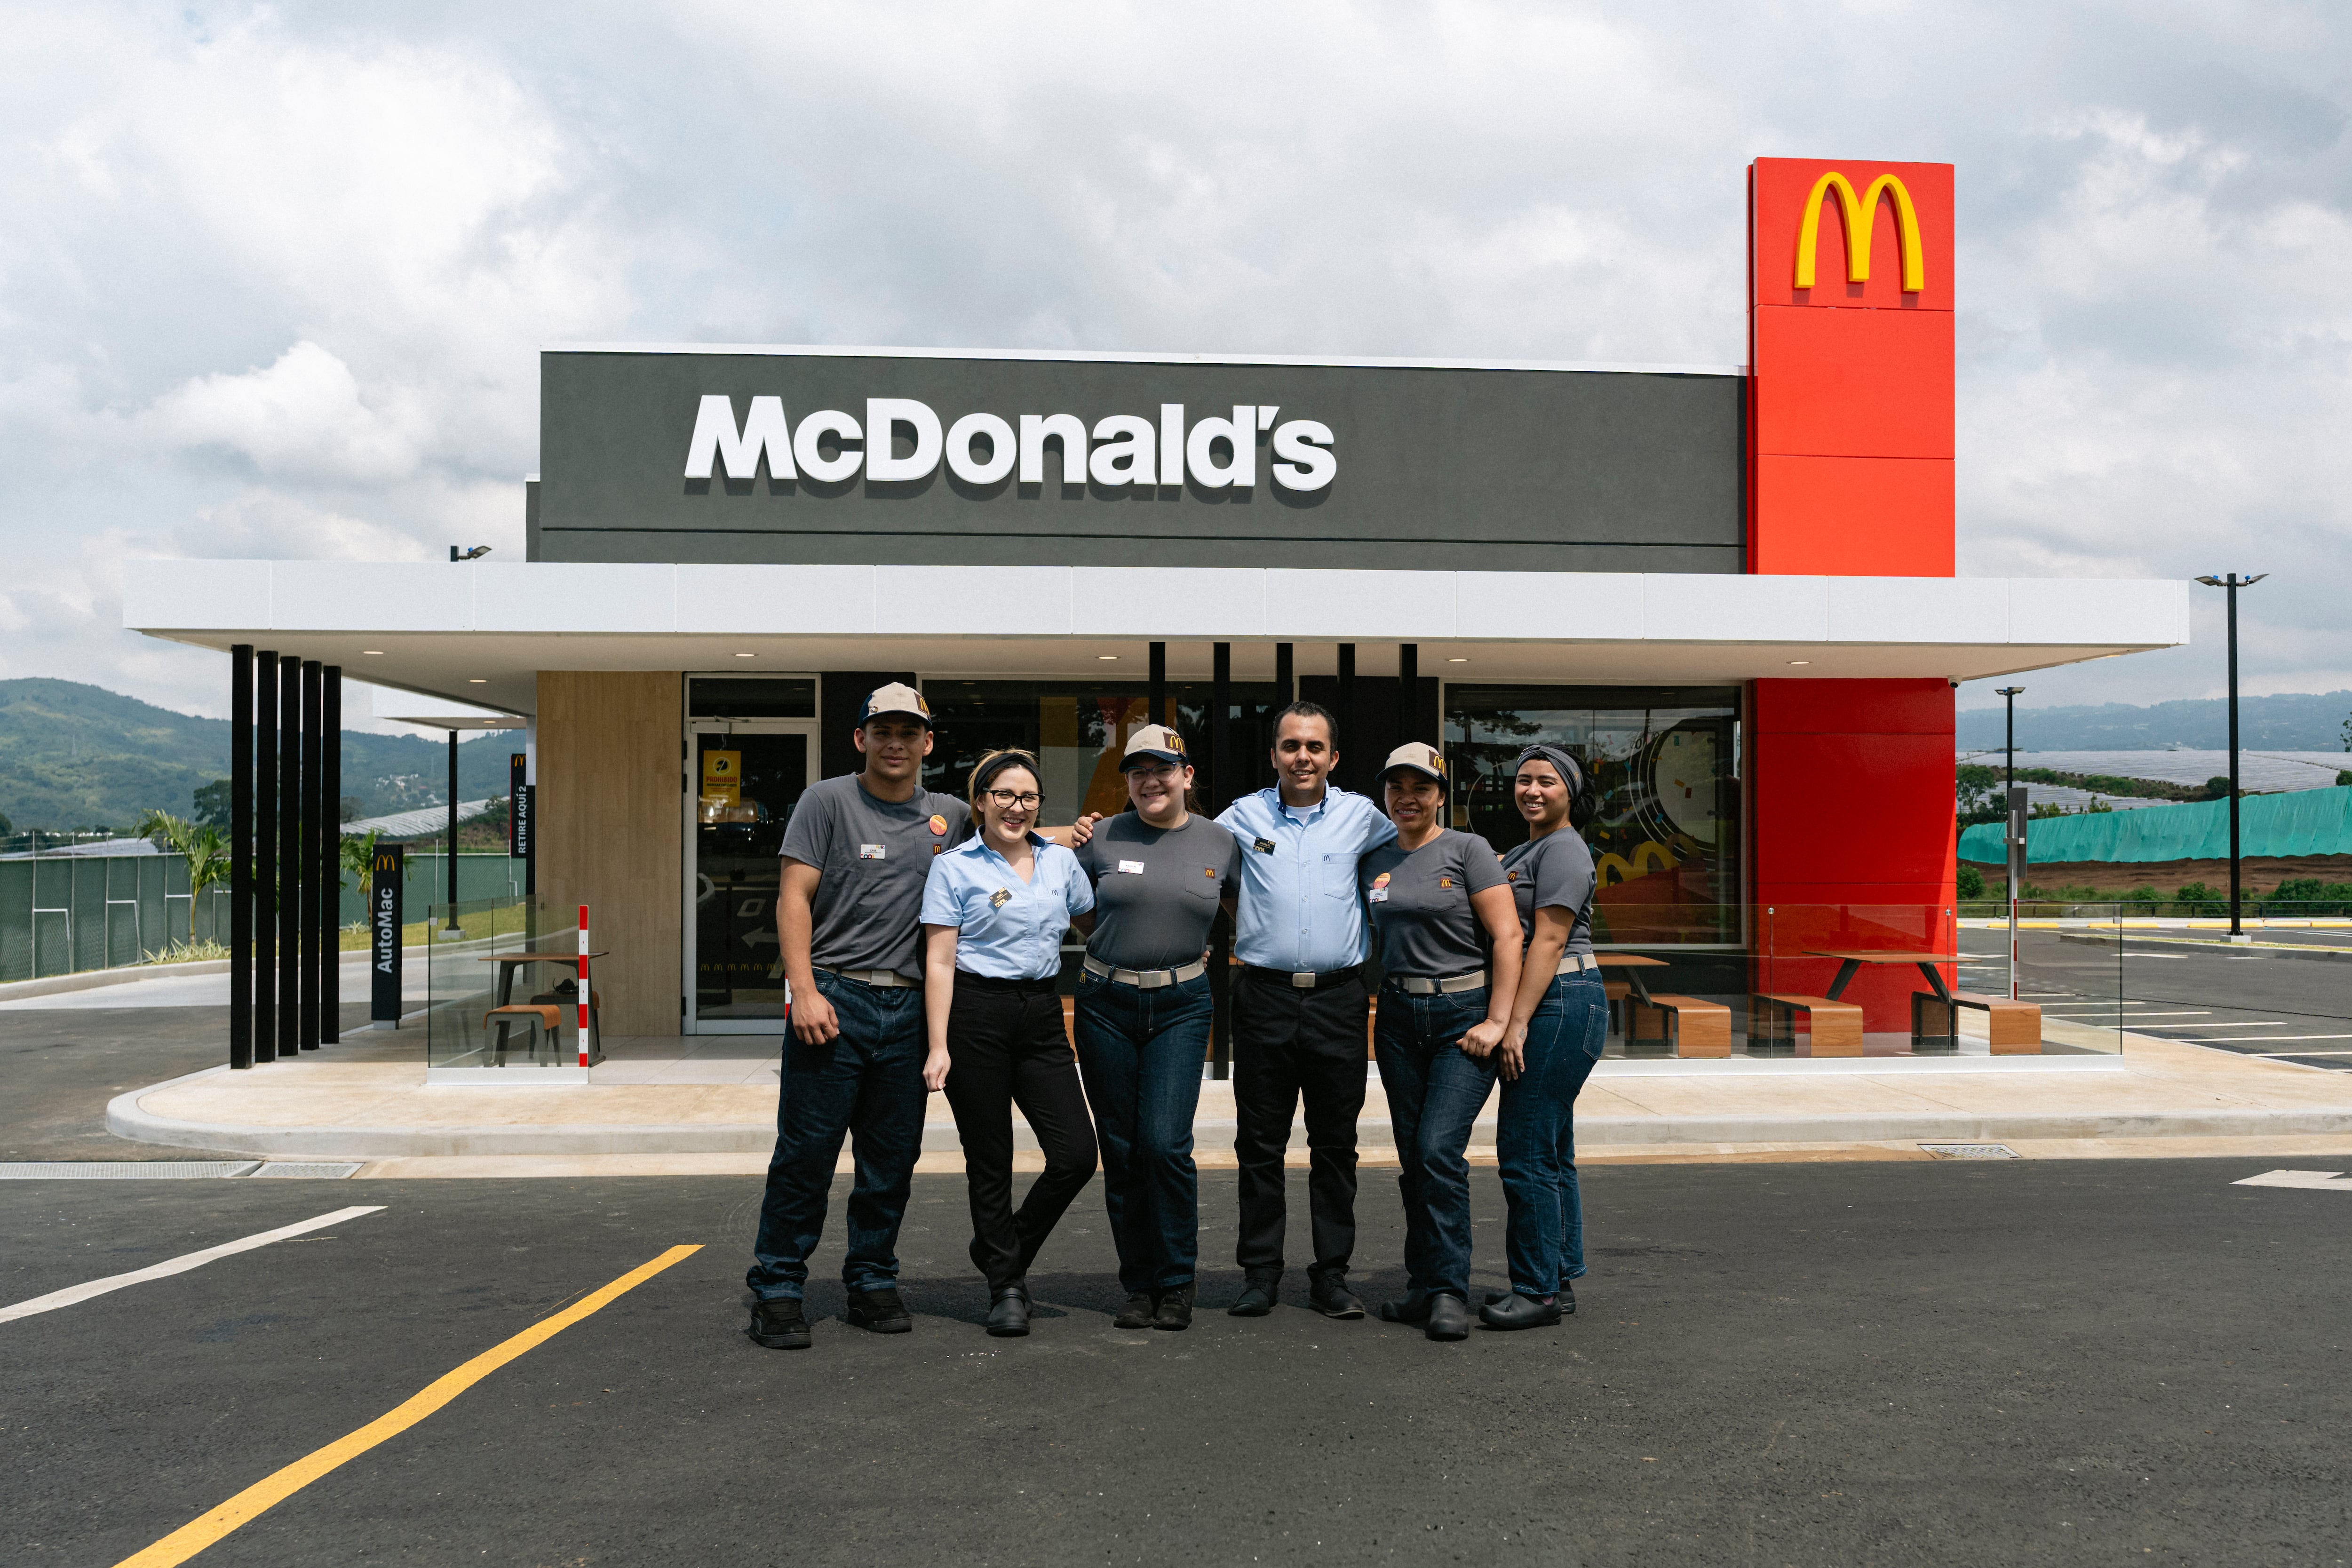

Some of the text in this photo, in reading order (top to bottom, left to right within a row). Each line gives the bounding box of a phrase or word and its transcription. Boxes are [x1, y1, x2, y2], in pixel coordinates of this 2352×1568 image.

[684, 395, 1336, 491] McDonald's
[516, 793, 527, 818] AQUÍ
[377, 888, 393, 973] AutoMac
